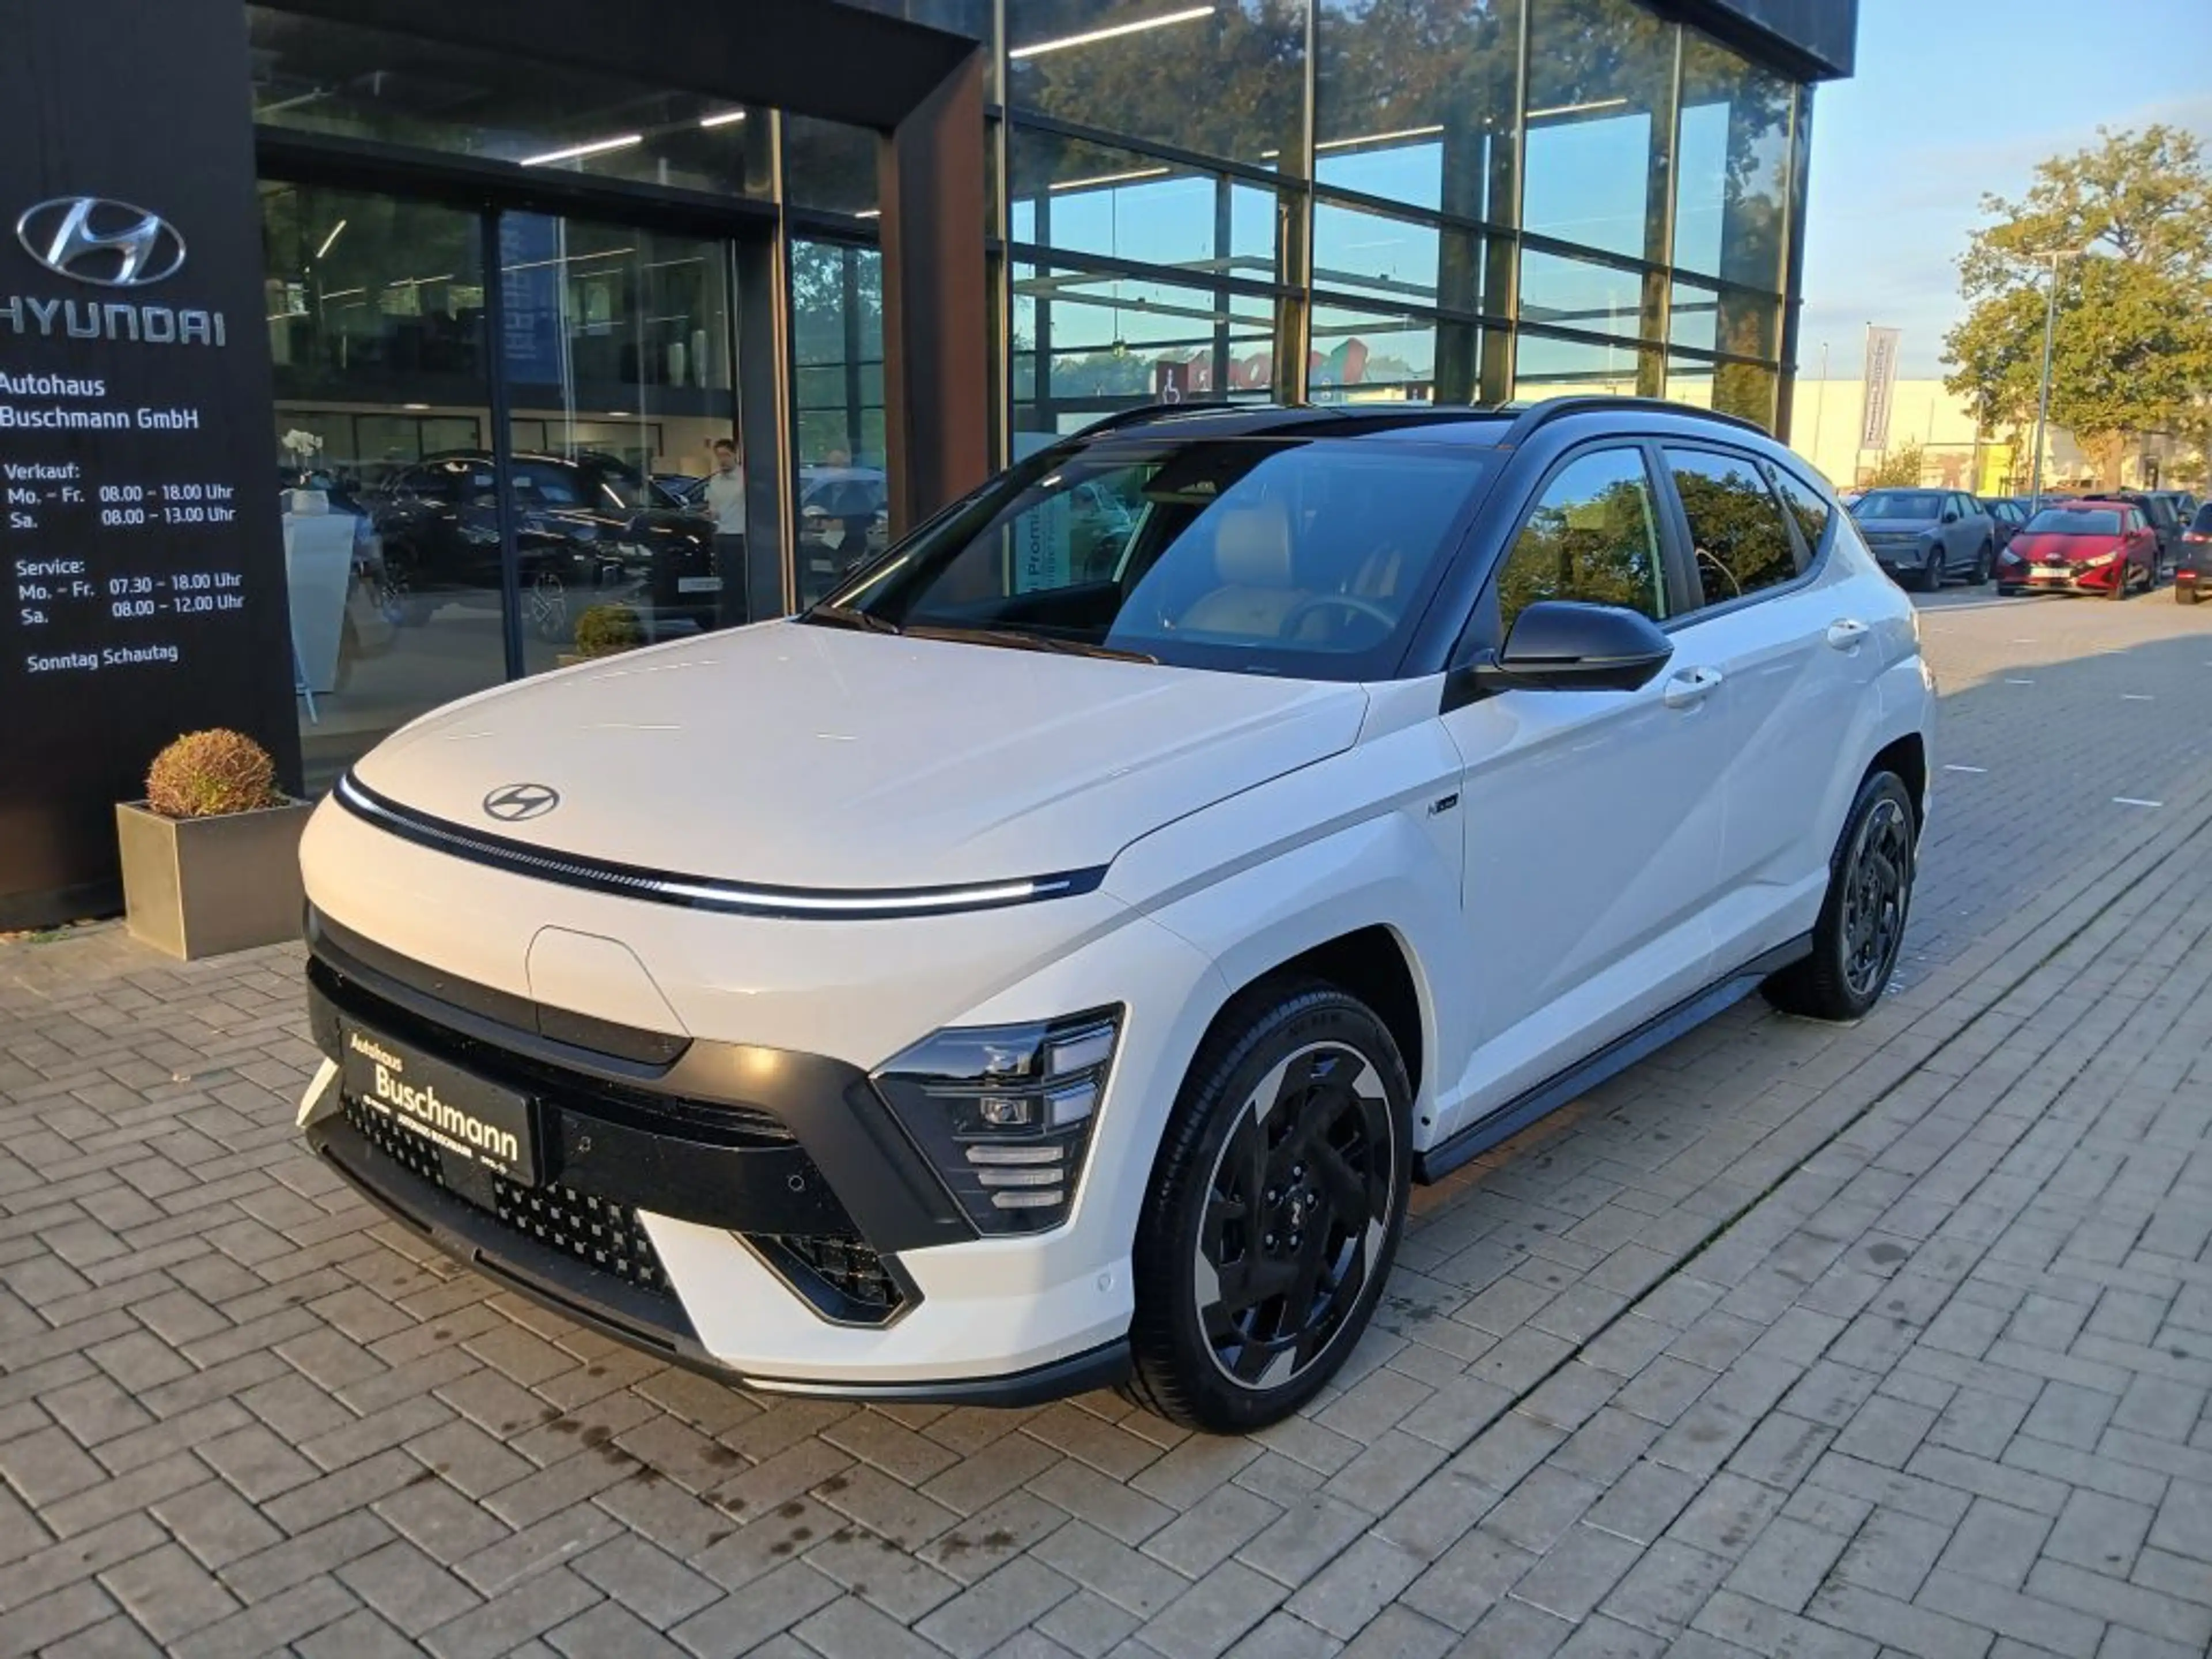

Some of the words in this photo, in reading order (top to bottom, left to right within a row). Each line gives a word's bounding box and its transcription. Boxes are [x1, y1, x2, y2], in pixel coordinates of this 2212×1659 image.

[0, 295, 226, 347] HYUNDAI
[0, 372, 105, 396] Autohaus
[0, 406, 130, 428] Buschmann
[137, 408, 199, 429] GmbH
[3, 463, 79, 480] Verkauf:
[7, 488, 41, 504] Mo.
[62, 486, 85, 502] Fr.
[99, 486, 143, 502] 08.00
[162, 484, 202, 501] 18.00
[205, 484, 234, 499] Uhr
[10, 512, 37, 528] Sa.
[101, 508, 145, 525] 08.00
[164, 507, 204, 523] 13.00
[207, 507, 236, 522] Uhr
[16, 558, 85, 577] Service:
[18, 584, 51, 600] Mo.
[73, 581, 94, 597] Fr.
[109, 577, 152, 595] 07.30
[172, 573, 211, 590] 18.00
[214, 573, 242, 587] Uhr
[21, 608, 48, 624] Sa.
[112, 600, 154, 617] 08.00
[173, 596, 213, 612] 12.00
[217, 594, 244, 609] Uhr
[27, 653, 99, 672] Sonntag
[103, 645, 178, 665] Schautag
[376, 1064, 518, 1161] Buschmann
